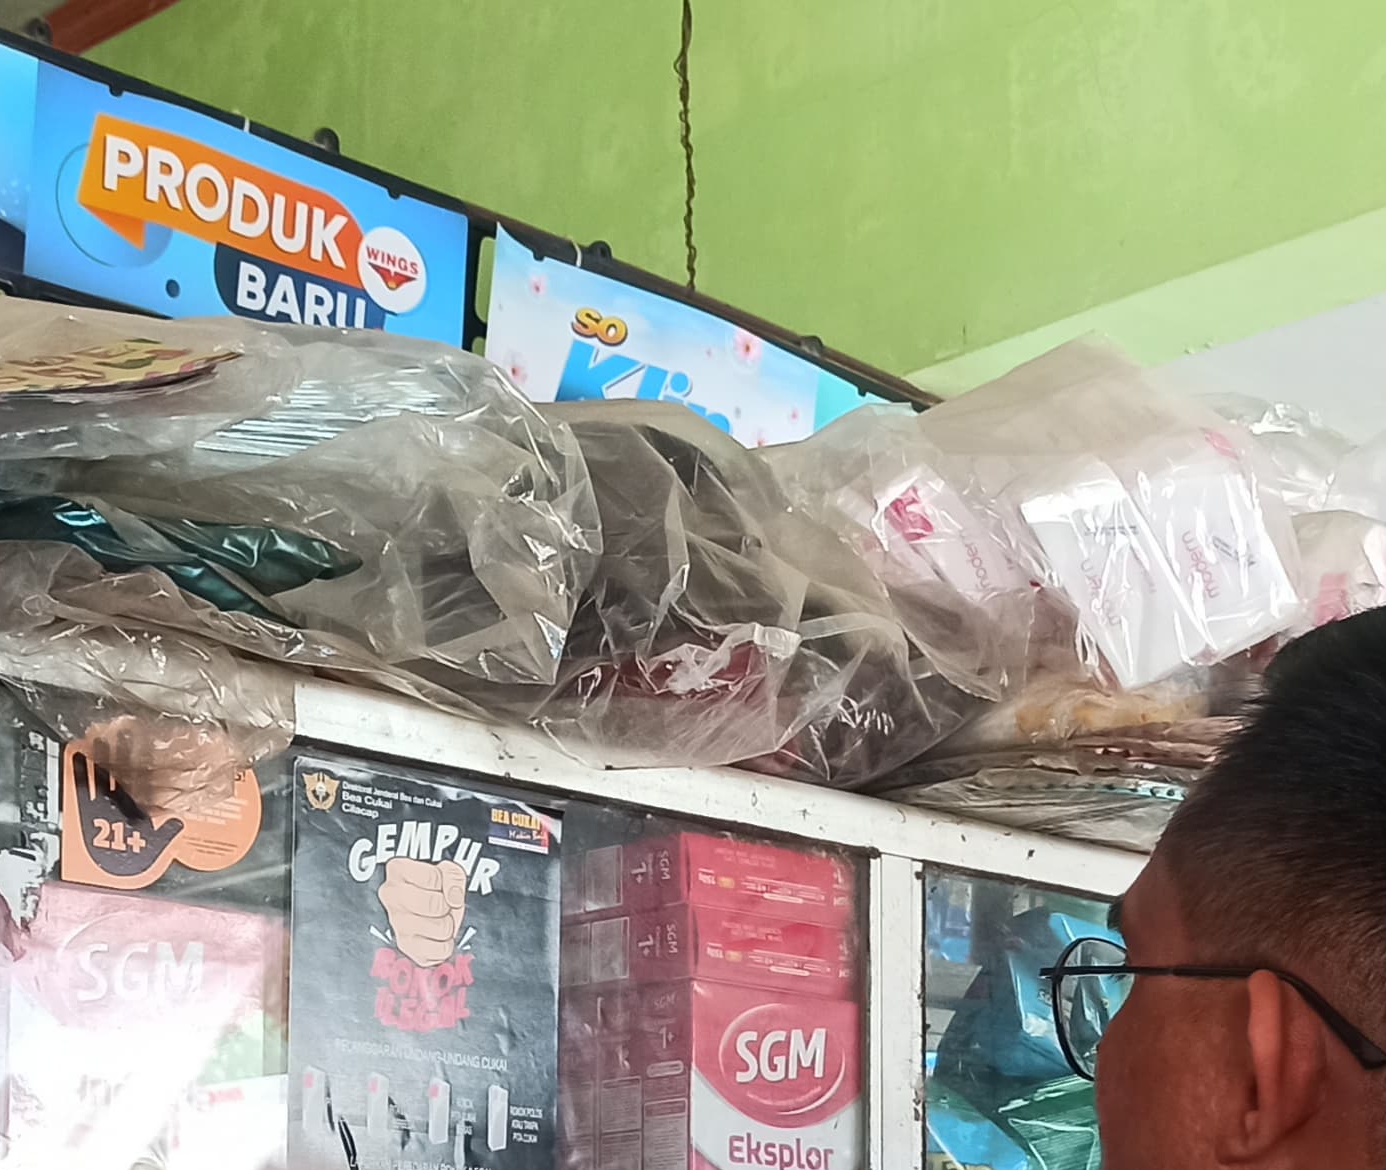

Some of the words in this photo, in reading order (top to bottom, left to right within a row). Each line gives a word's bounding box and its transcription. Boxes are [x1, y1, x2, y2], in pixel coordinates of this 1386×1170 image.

[102, 133, 349, 270] PRODUK
[365, 245, 419, 280] WINGS
[236, 260, 367, 329] BARU
[554, 339, 730, 434] Kl
[92, 818, 146, 853] 21+
[341, 803, 379, 819] Cilacap
[491, 808, 510, 822] BEA
[348, 821, 500, 896] GEMPUR
[76, 941, 205, 1001] SGM
[735, 1027, 827, 1083] SGM
